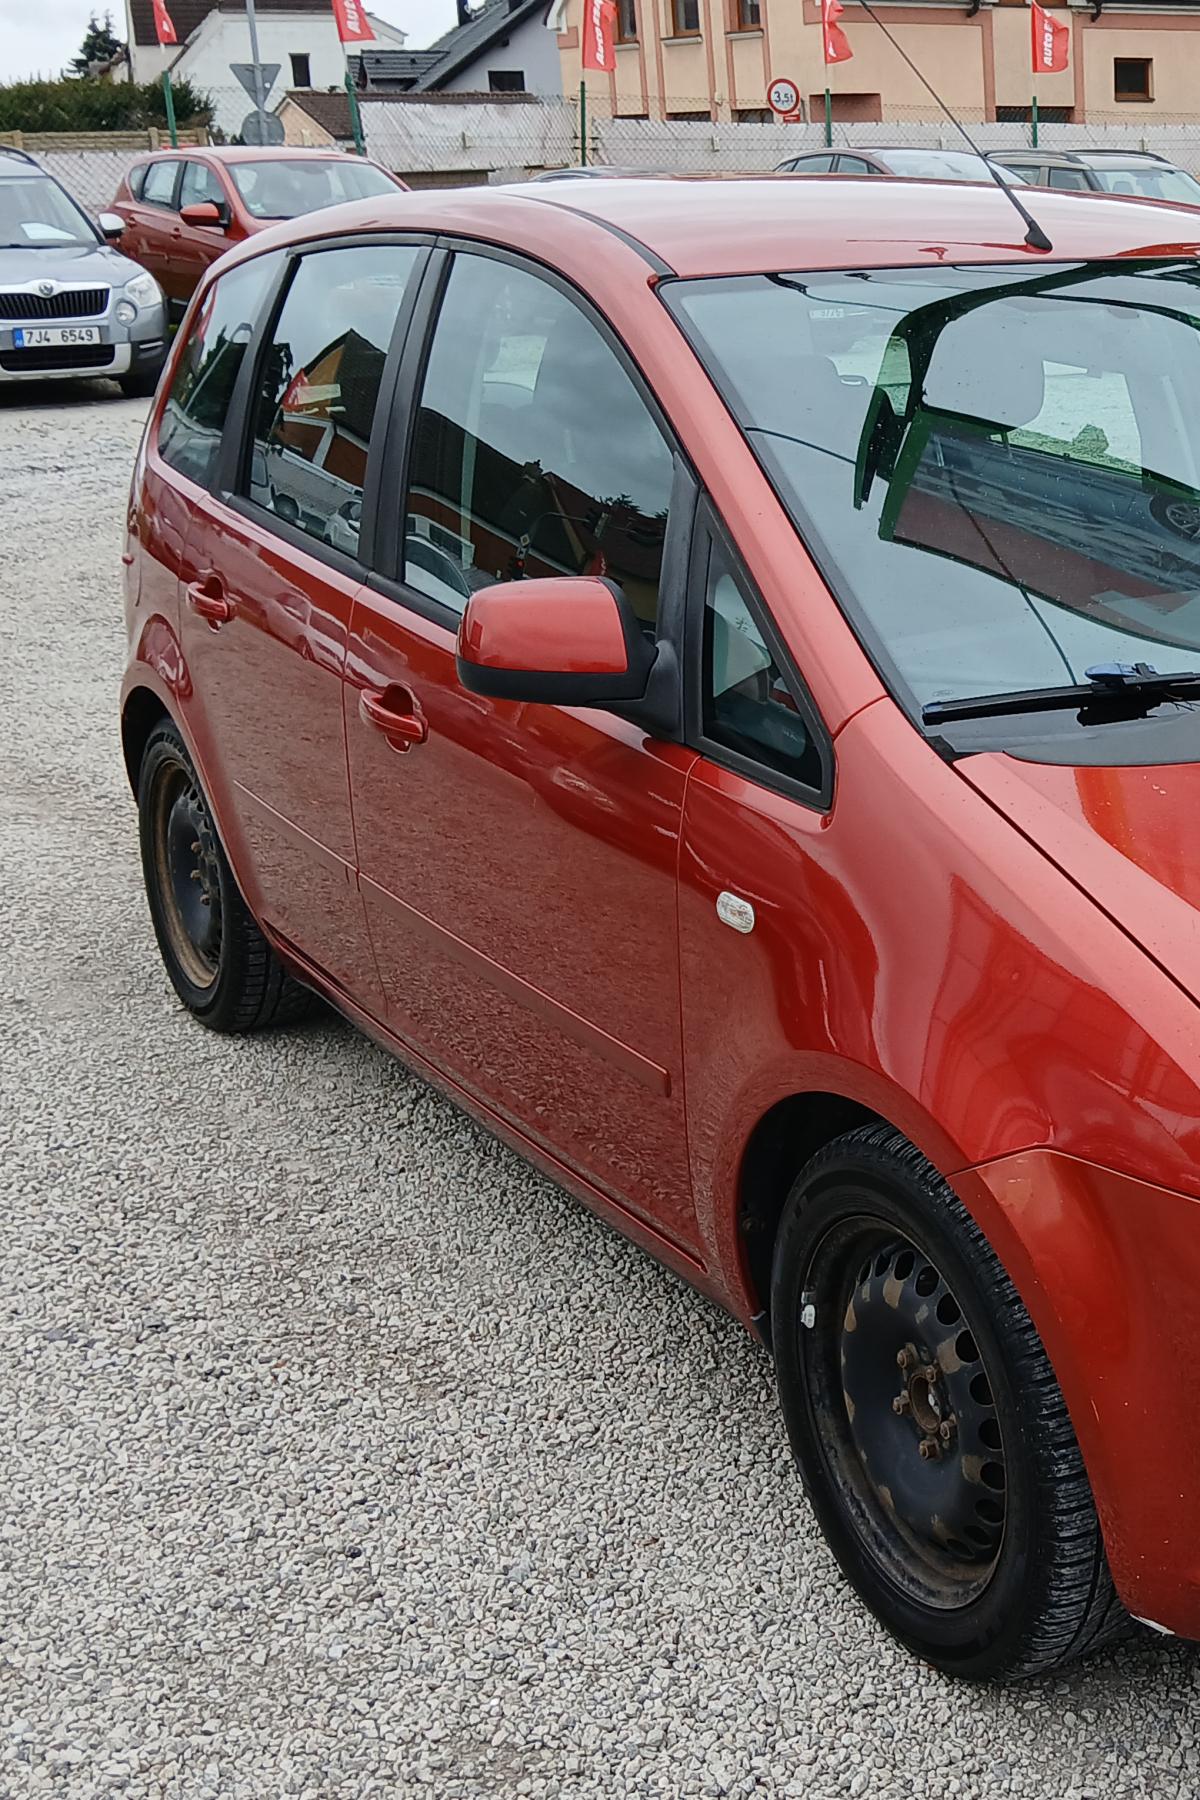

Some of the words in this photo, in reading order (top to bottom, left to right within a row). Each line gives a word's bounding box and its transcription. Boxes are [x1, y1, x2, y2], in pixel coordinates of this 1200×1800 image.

[1043, 31, 1054, 67] Auto
[773, 90, 794, 105] 3,5t
[26, 331, 50, 344] 7J4
[60, 329, 94, 343] 6549
